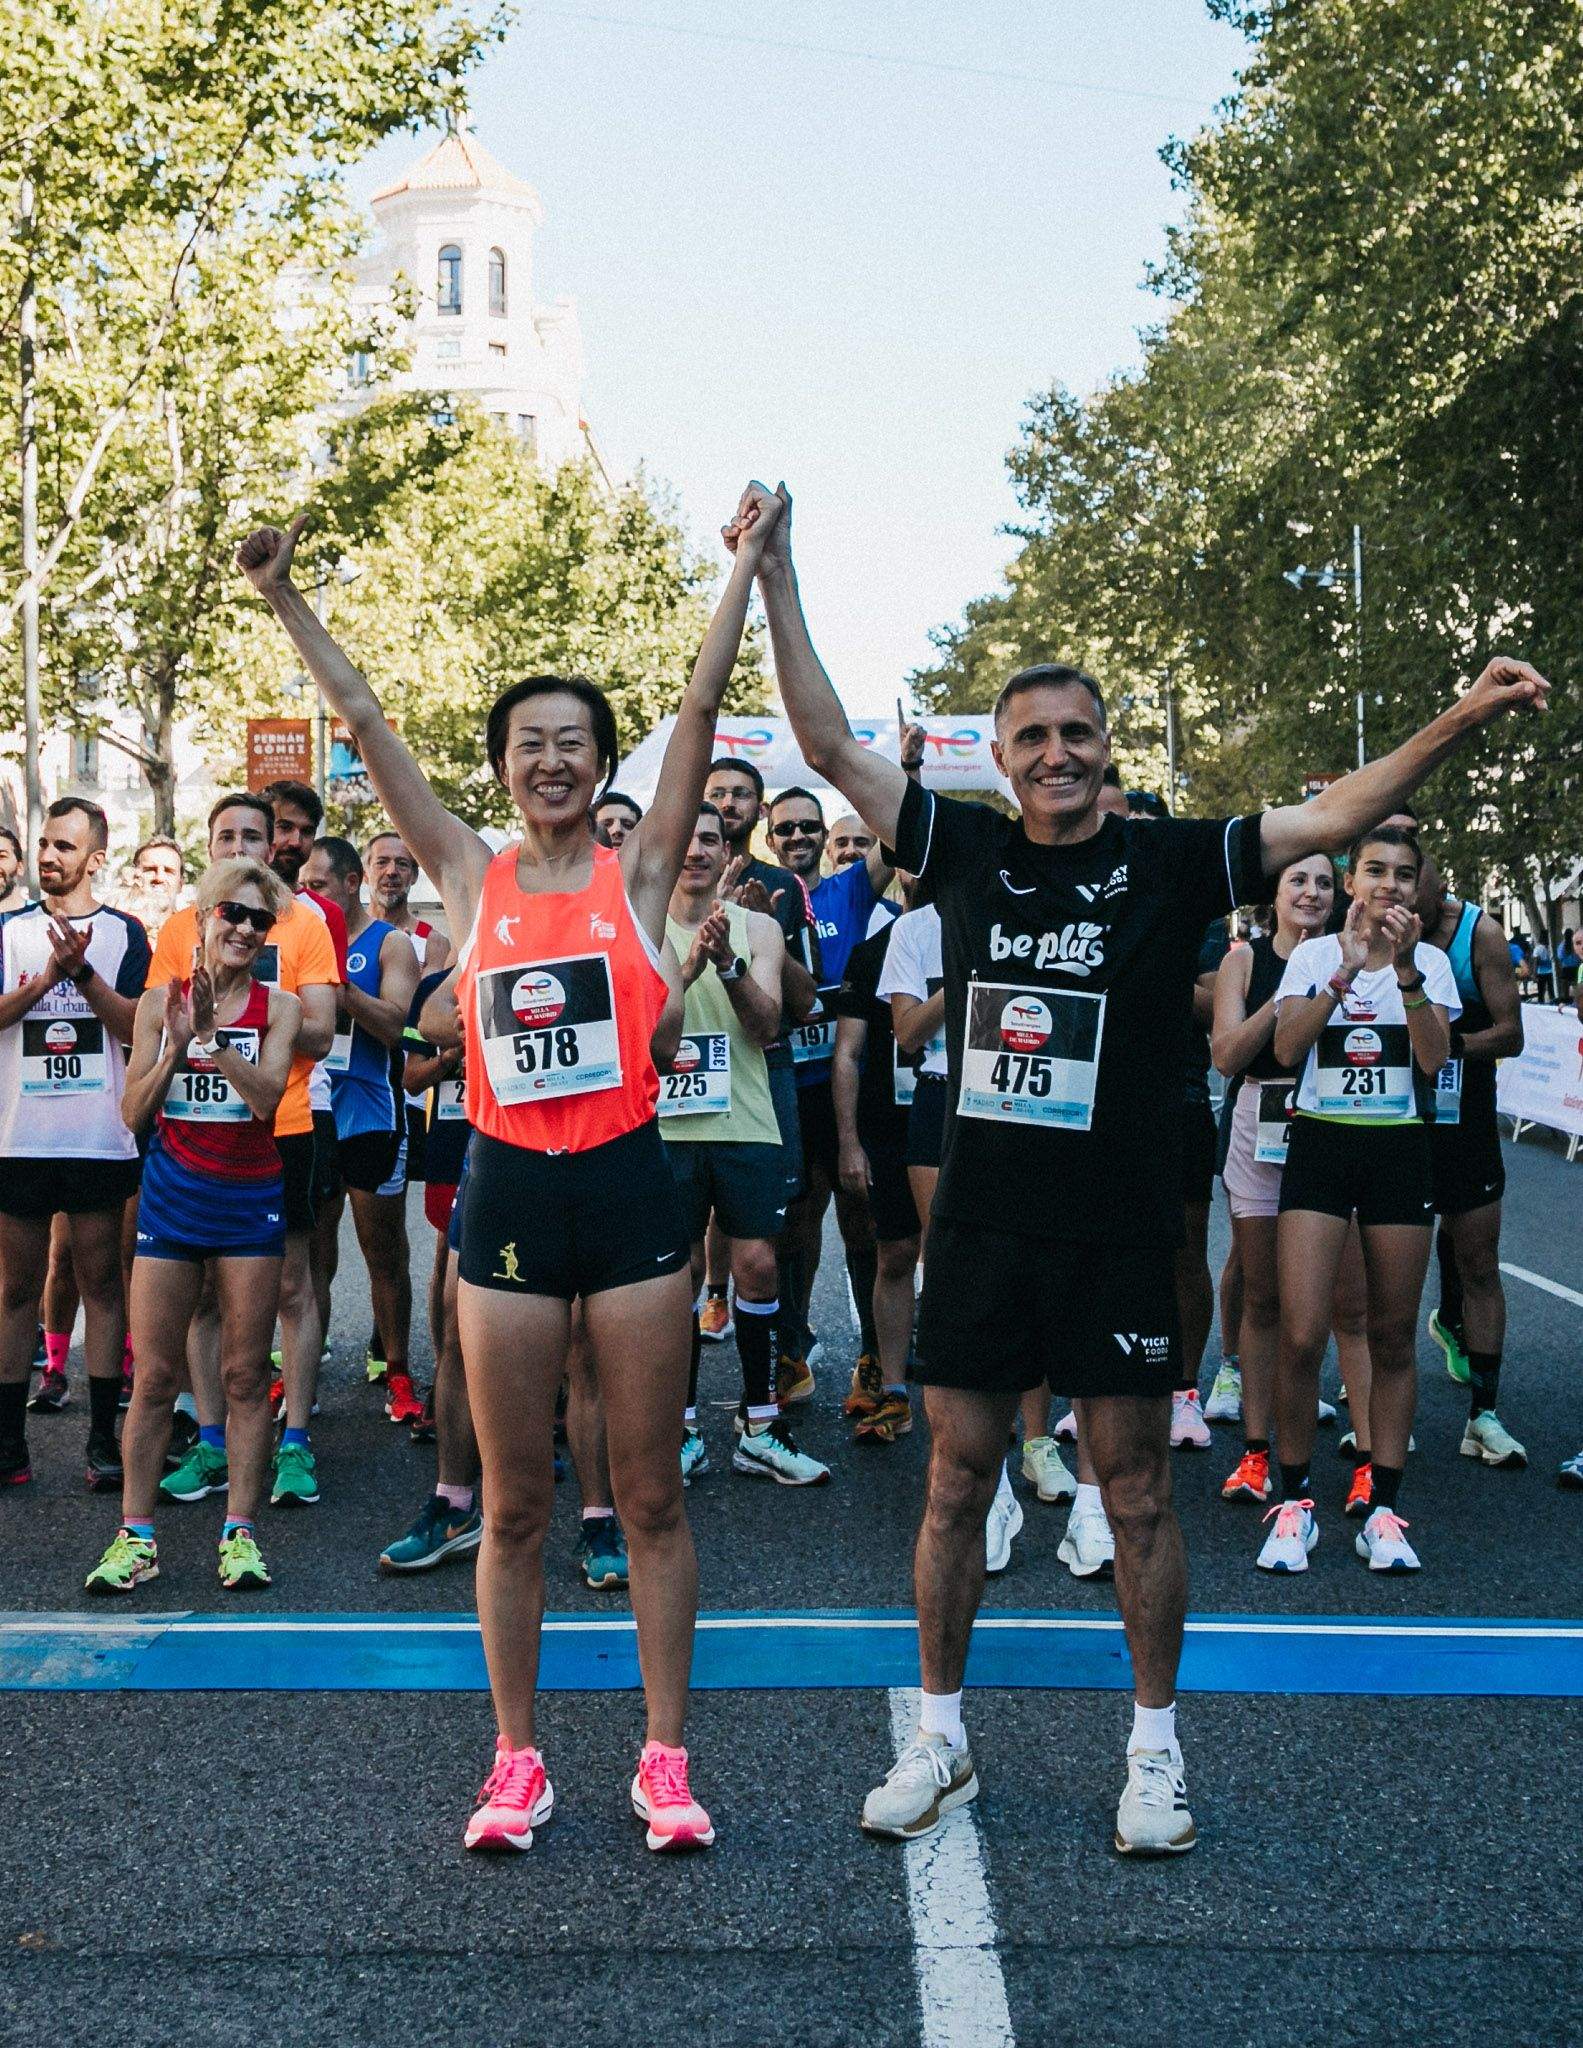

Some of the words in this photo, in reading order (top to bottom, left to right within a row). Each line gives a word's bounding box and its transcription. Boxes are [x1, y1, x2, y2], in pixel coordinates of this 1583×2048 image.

[253, 731, 306, 743] FERNÁN
[816, 920, 839, 939] lia
[990, 923, 1034, 961] be
[1035, 923, 1105, 969] plus
[799, 1022, 830, 1048] 197
[512, 1027, 580, 1074] 578
[712, 1039, 726, 1067] 3192
[43, 1056, 82, 1080] 190
[991, 1054, 1052, 1098] 475
[1341, 1068, 1387, 1095] 231
[182, 1074, 228, 1103] 185
[666, 1073, 707, 1099] 225
